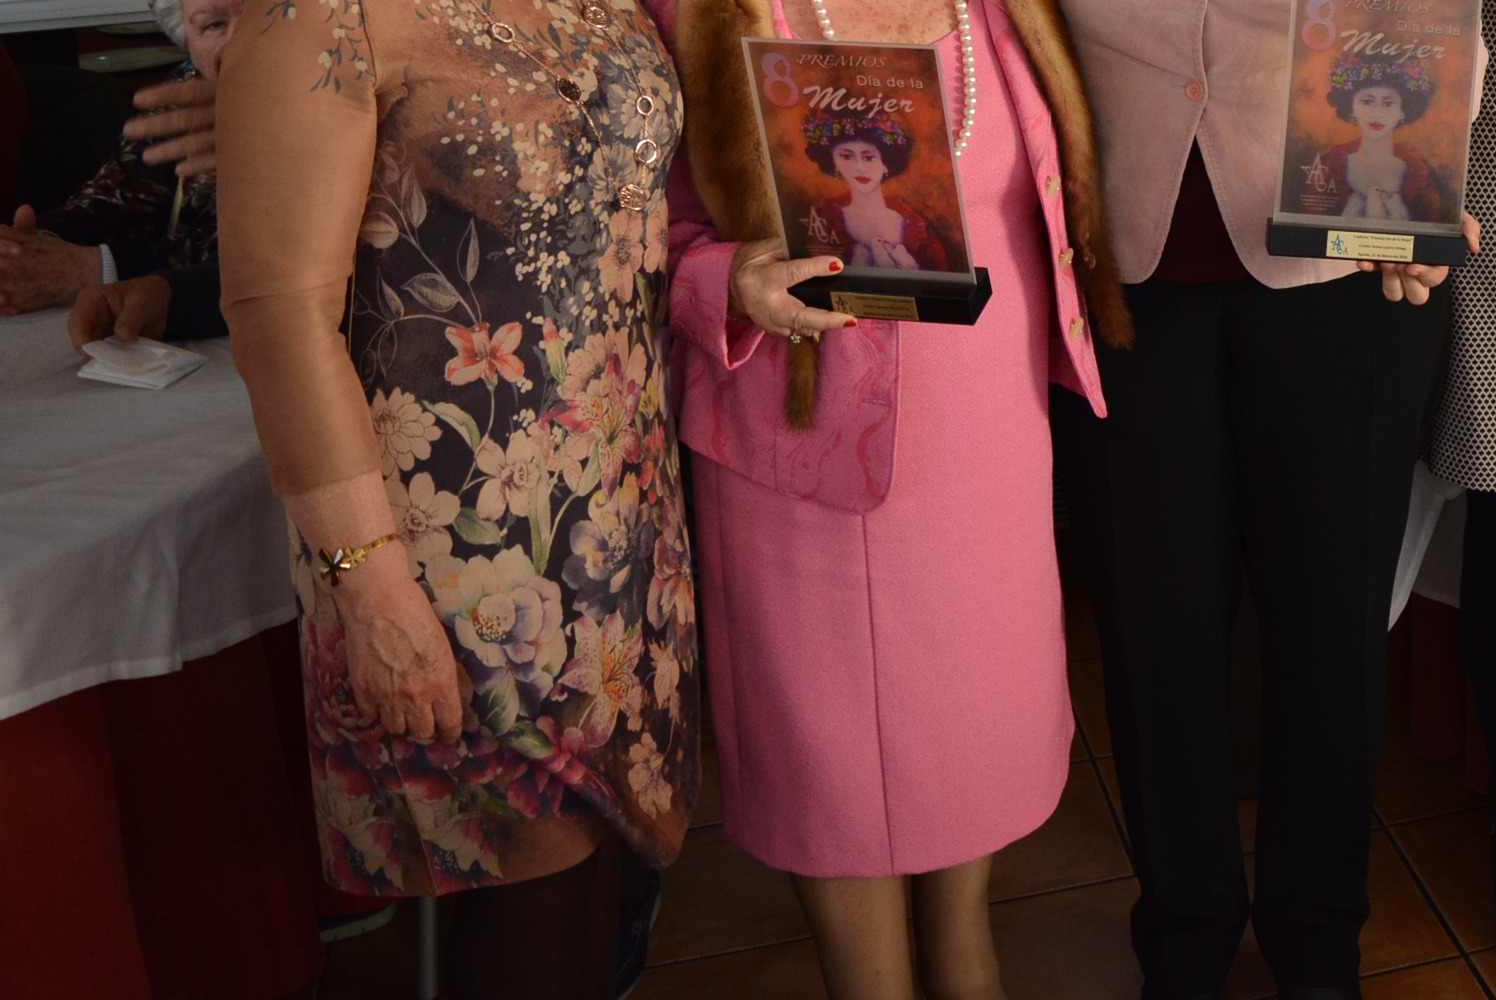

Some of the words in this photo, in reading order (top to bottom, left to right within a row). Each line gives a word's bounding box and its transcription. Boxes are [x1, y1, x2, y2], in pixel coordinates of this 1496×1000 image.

[1396, 20, 1420, 33] Día
[1425, 22, 1443, 34] de
[1449, 24, 1461, 36] la
[1340, 29, 1446, 63] Mujer
[795, 54, 887, 69] PREMIOS
[856, 75, 881, 87] Día
[886, 77, 905, 88] de
[910, 78, 924, 89] la
[802, 85, 915, 119] Mujer
